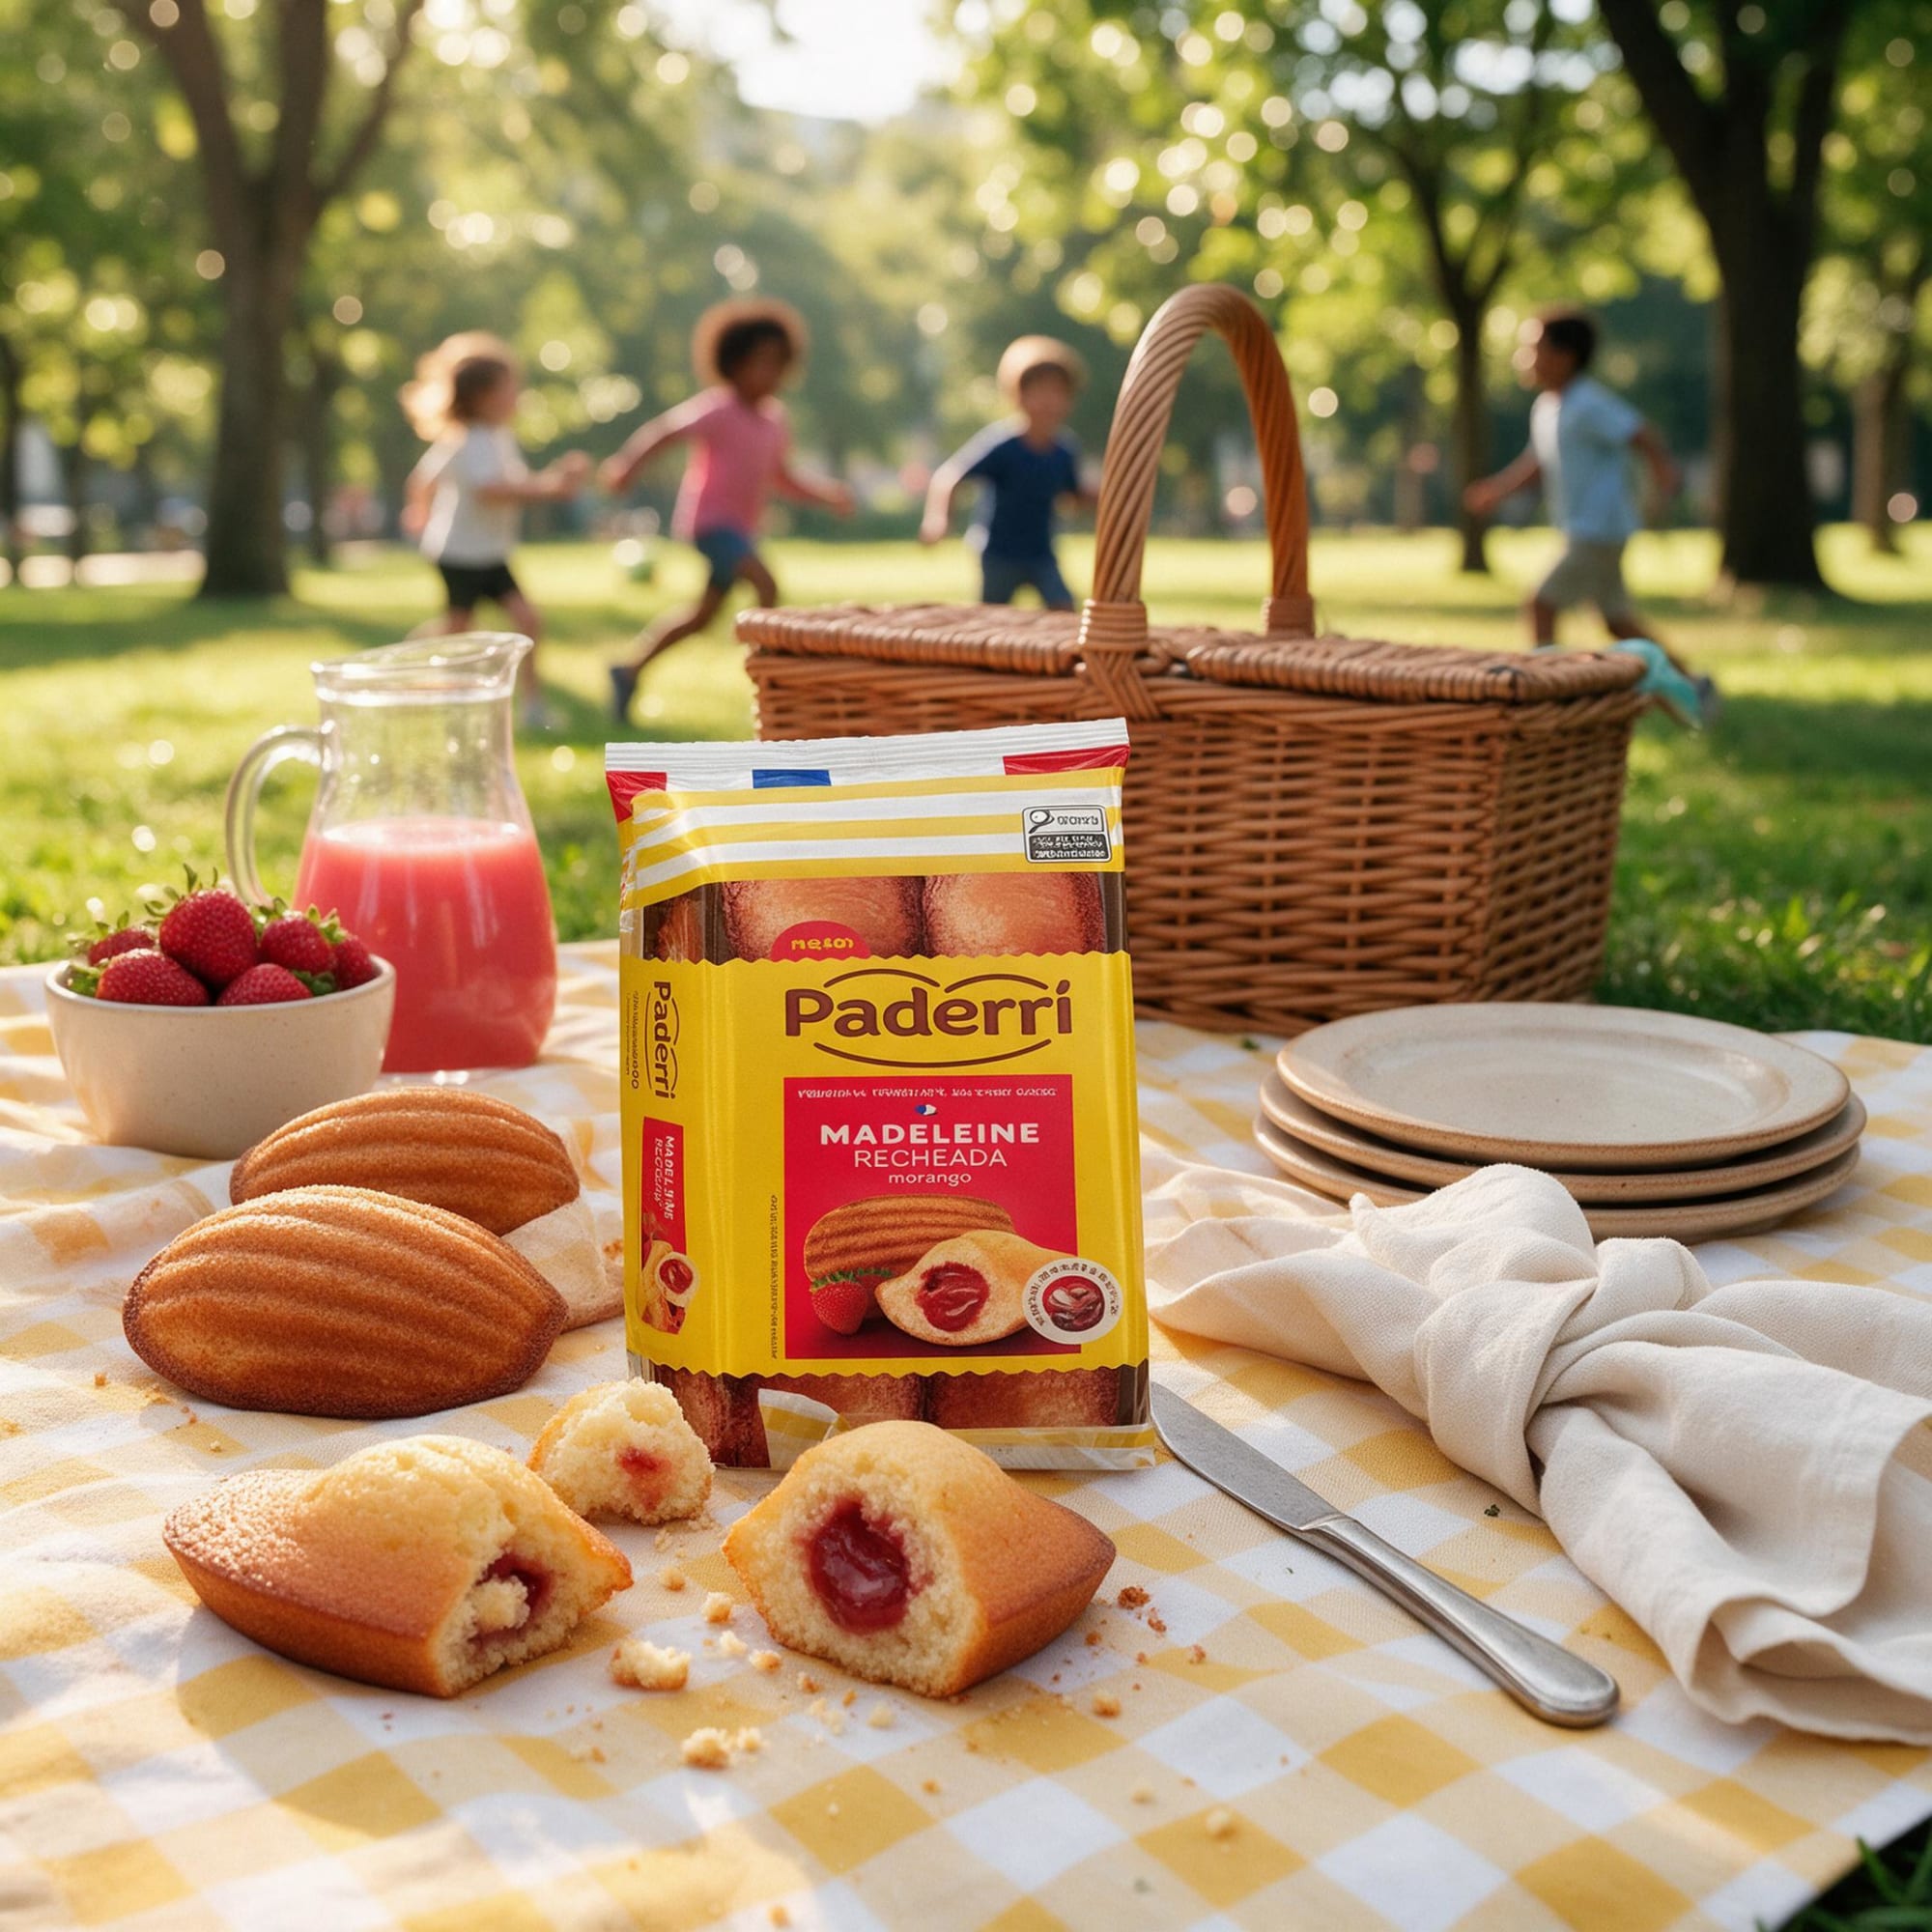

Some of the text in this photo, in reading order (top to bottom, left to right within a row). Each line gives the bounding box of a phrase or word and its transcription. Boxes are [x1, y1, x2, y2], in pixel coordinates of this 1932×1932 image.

[820, 1122, 1039, 1146] MADELEINE
[854, 1149, 1008, 1168] RECHEADA
[889, 1173, 972, 1187] morango
